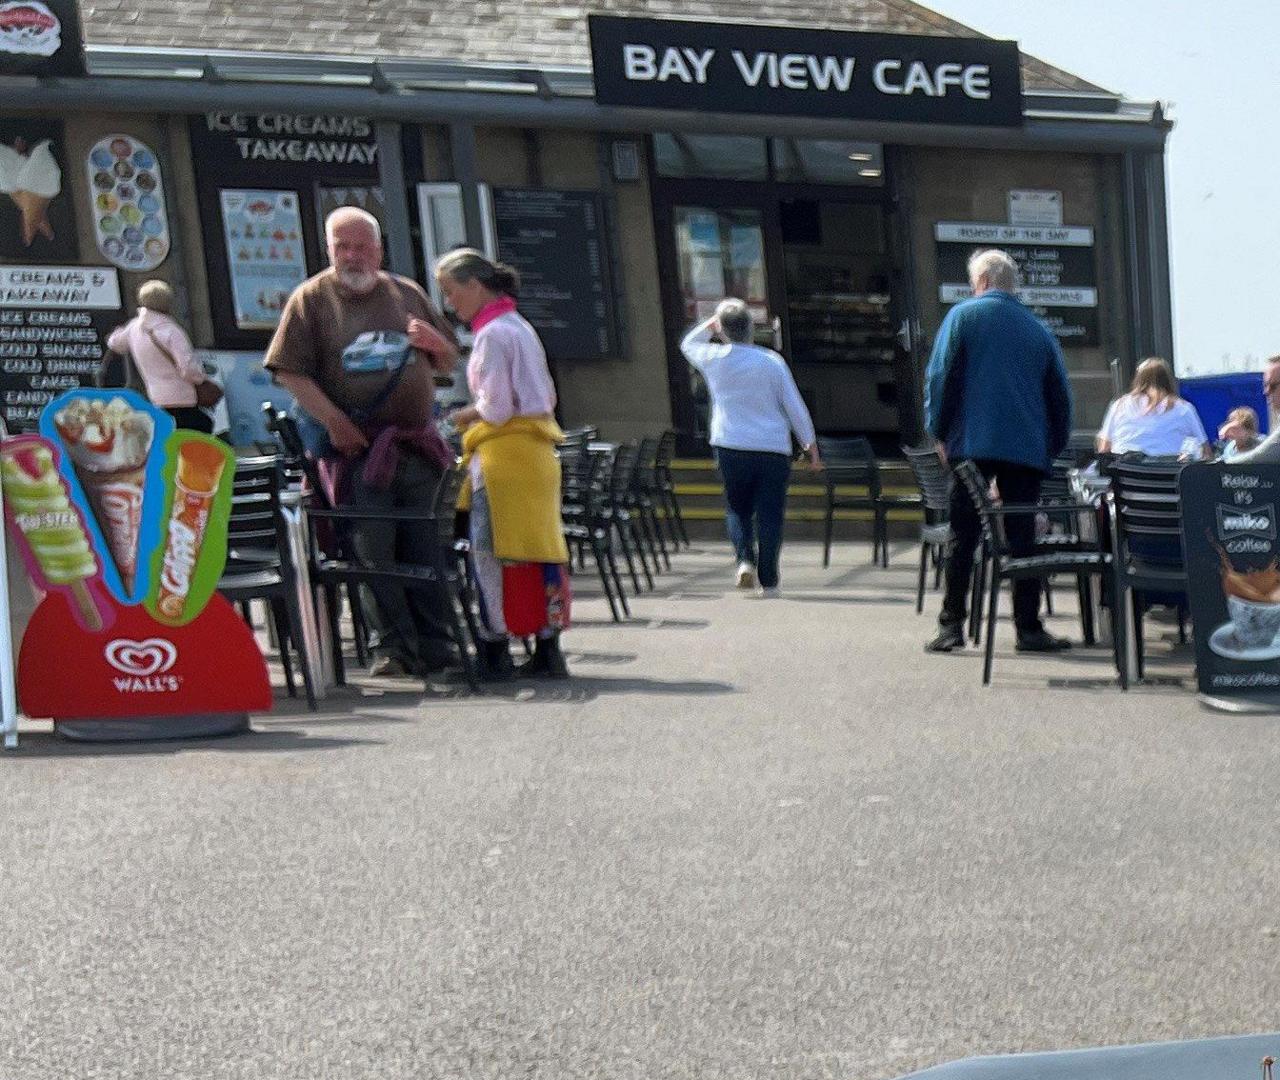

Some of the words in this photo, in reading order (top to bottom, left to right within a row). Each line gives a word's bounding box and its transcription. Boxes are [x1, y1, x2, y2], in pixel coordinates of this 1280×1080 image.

[622, 43, 715, 84] BAY
[731, 50, 856, 92] VIEW
[872, 58, 992, 100] CAFE
[206, 112, 249, 132] ICE
[256, 113, 371, 137] CREAMS
[236, 137, 378, 165] TAKEAWAY
[28, 311, 92, 327] CREAMS
[0, 327, 98, 343] SANDWICHES
[42, 343, 103, 358] SNACKS
[4, 359, 43, 374] COLD
[30, 375, 81, 390] CAKES
[1222, 514, 1271, 531] miko
[1225, 540, 1273, 554] coffee
[112, 676, 178, 693] WALL'S
